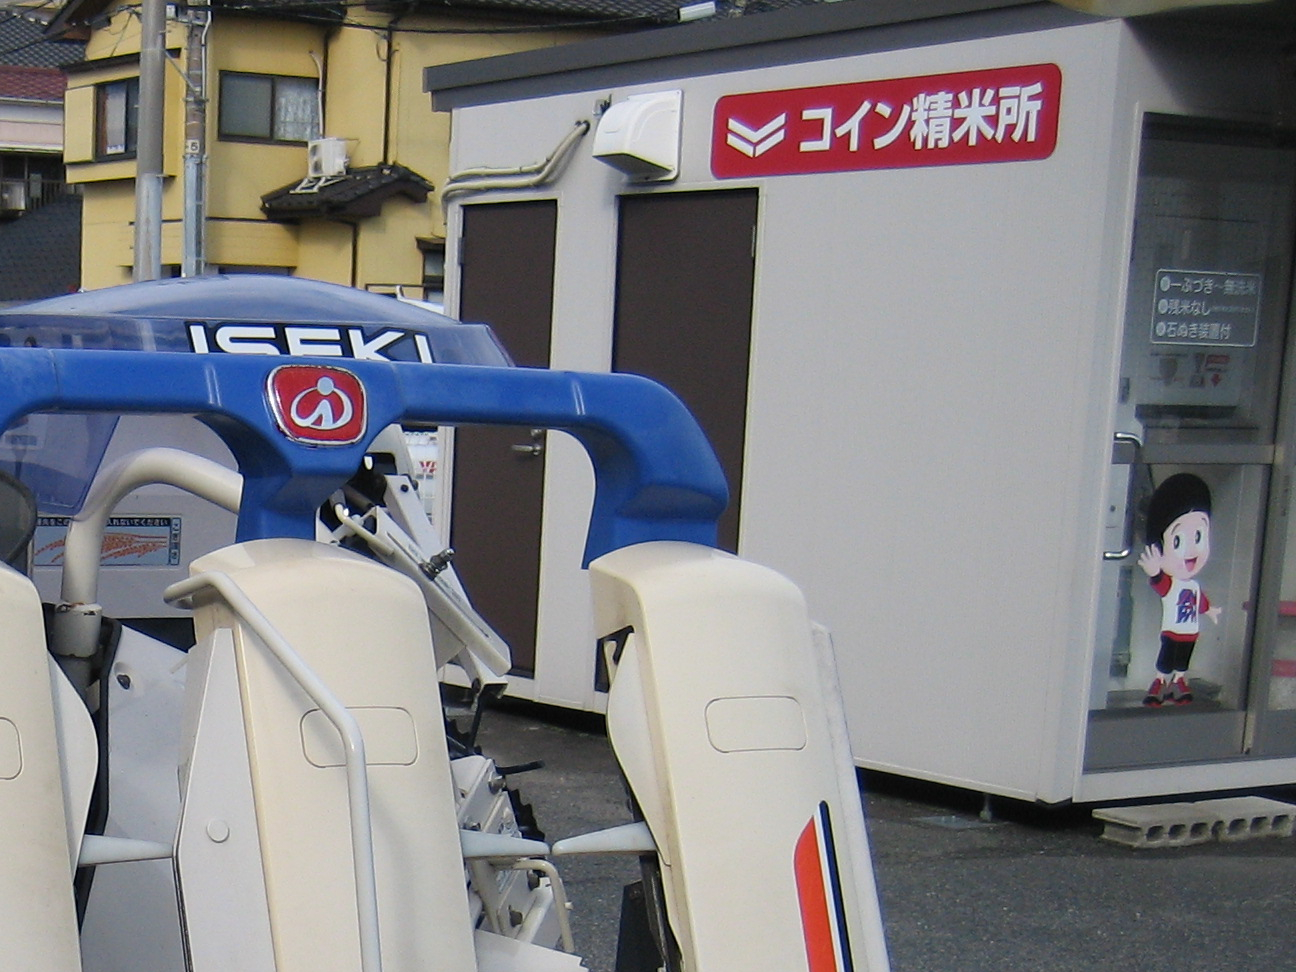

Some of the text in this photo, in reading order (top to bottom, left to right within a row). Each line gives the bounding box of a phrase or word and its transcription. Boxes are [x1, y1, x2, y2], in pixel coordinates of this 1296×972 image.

[798, 80, 1045, 154] コイン精米所
[187, 323, 434, 364] ISEKI
